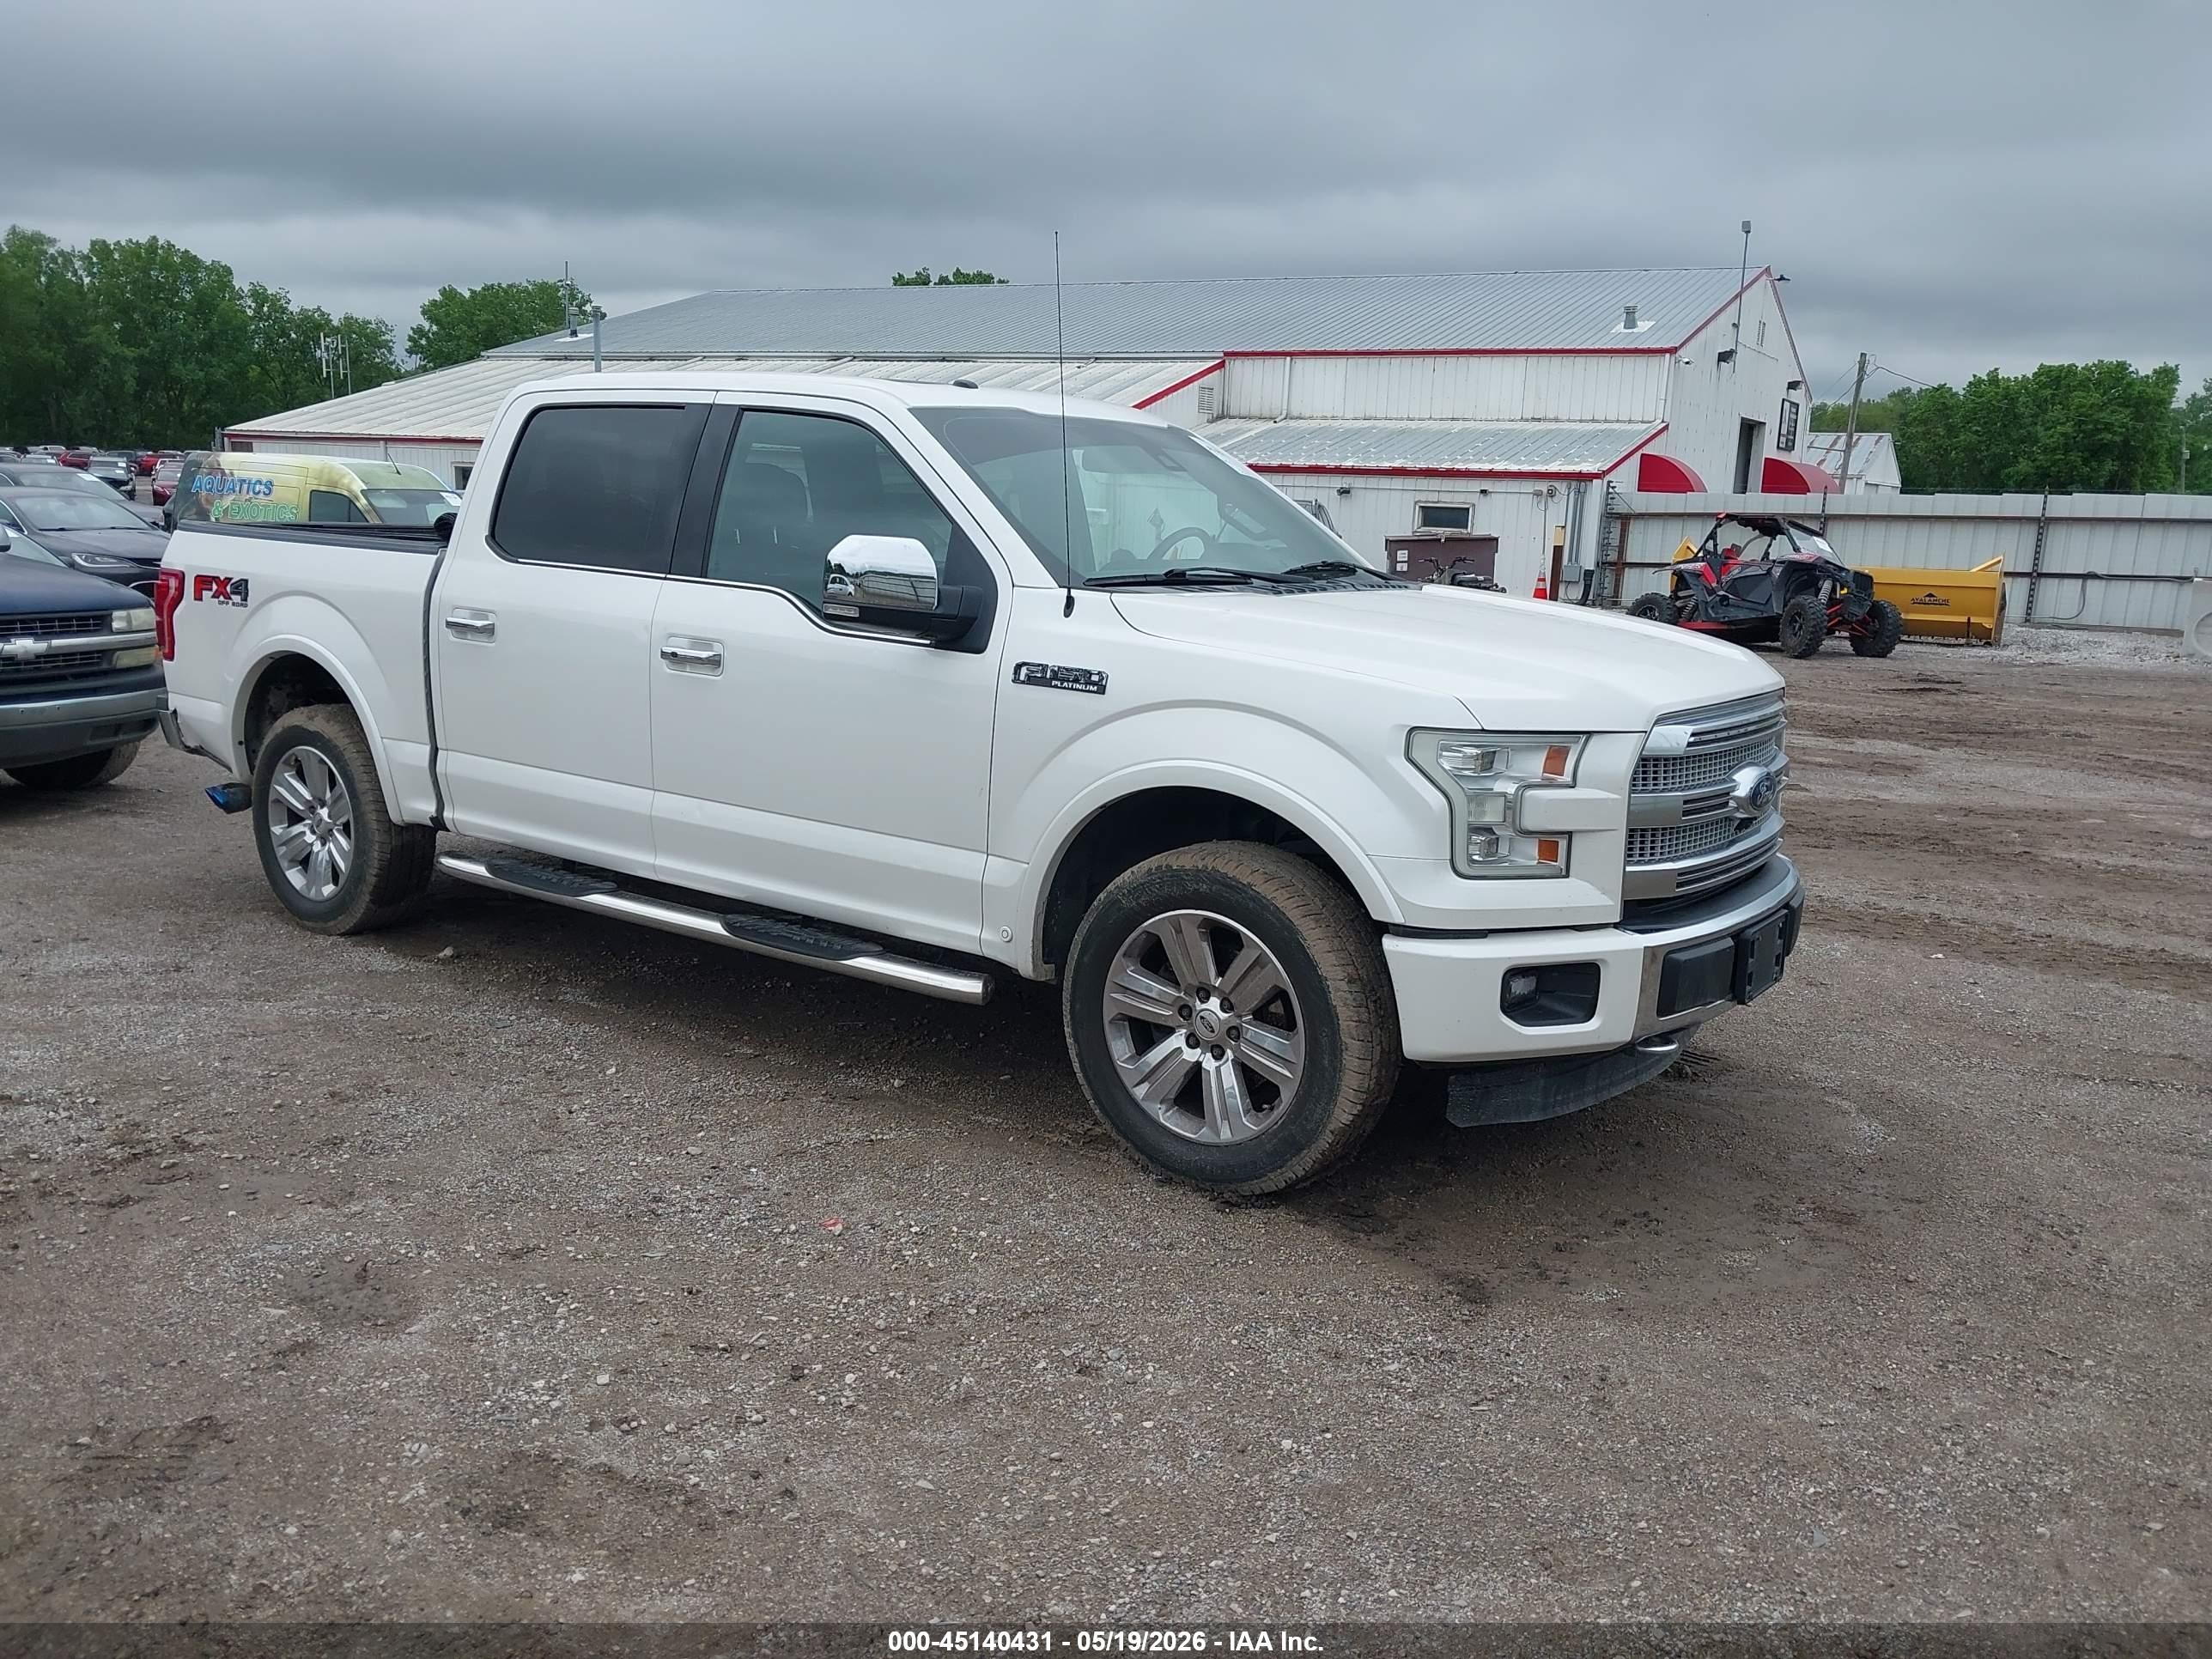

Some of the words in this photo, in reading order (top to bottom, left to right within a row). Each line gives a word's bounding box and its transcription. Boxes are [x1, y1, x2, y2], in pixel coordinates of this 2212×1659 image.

[191, 475, 273, 496] AQUATICS
[211, 500, 223, 518] &
[228, 501, 299, 521] EXOTICS
[193, 574, 248, 601] FX4
[1051, 680, 1097, 691] PLATINUM
